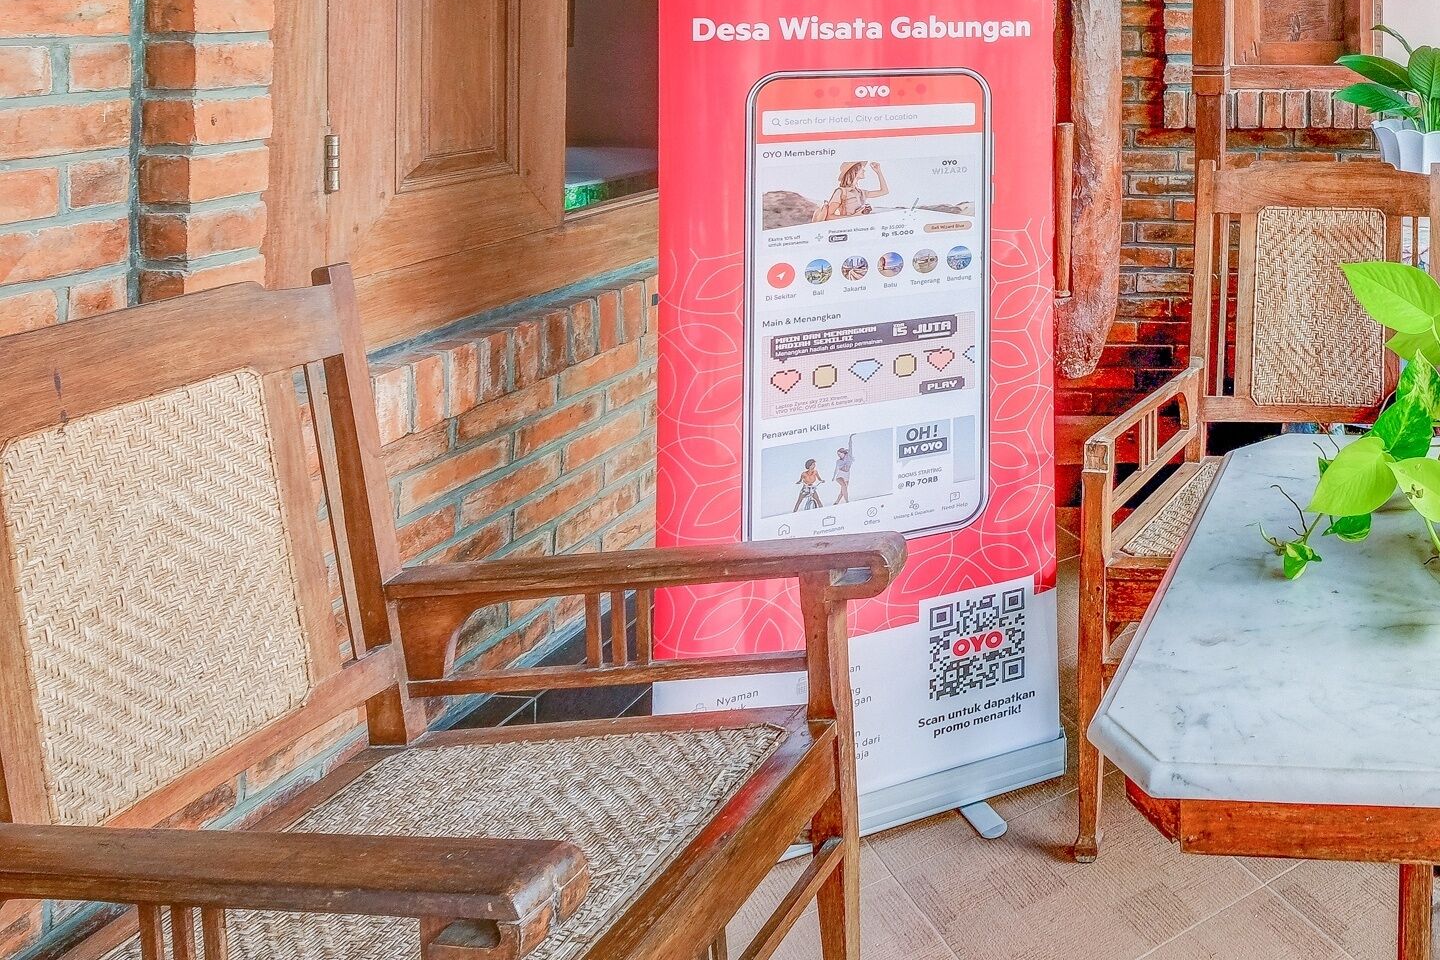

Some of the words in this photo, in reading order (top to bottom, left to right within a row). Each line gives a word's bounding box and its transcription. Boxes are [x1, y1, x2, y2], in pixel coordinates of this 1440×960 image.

[692, 17, 770, 42] Desa
[779, 15, 883, 41] Wisata
[890, 15, 1032, 43] Gabungan
[854, 85, 891, 98] OYO
[784, 116, 813, 126] Search
[815, 116, 826, 125] for
[855, 114, 871, 123] City
[885, 112, 918, 121] Location
[762, 150, 782, 159] OYO
[784, 148, 836, 158] Membership
[910, 277, 941, 286] Tangerang
[843, 285, 867, 293] Jakarta
[774, 292, 797, 301] Sekitar
[762, 319, 783, 328] Main
[785, 317, 791, 325] &
[793, 312, 841, 323] Menangkan
[912, 320, 952, 334] JUTA
[775, 335, 800, 344] MAIN
[802, 333, 821, 341] DAN
[775, 341, 811, 350] HADIAH
[775, 348, 809, 357] Menangkan
[809, 345, 829, 353] hadiah
[836, 342, 853, 350] setiap
[927, 379, 958, 391] PLAY
[761, 427, 808, 440] Penawaran
[809, 423, 830, 432] Kilat
[903, 445, 919, 455] MY
[920, 440, 943, 452] OYO
[898, 471, 917, 479] ROOMS
[918, 467, 943, 476] STARTING
[905, 480, 915, 488] Rp
[863, 518, 880, 526] Offers
[952, 631, 1003, 657] OYO
[716, 689, 759, 707] Nyaman
[918, 714, 945, 728] Scan
[948, 703, 981, 720] untuk
[983, 690, 1036, 710] dapatkan
[933, 720, 971, 738] promo
[973, 704, 1022, 726] menarik!
[862, 734, 880, 747] dari
